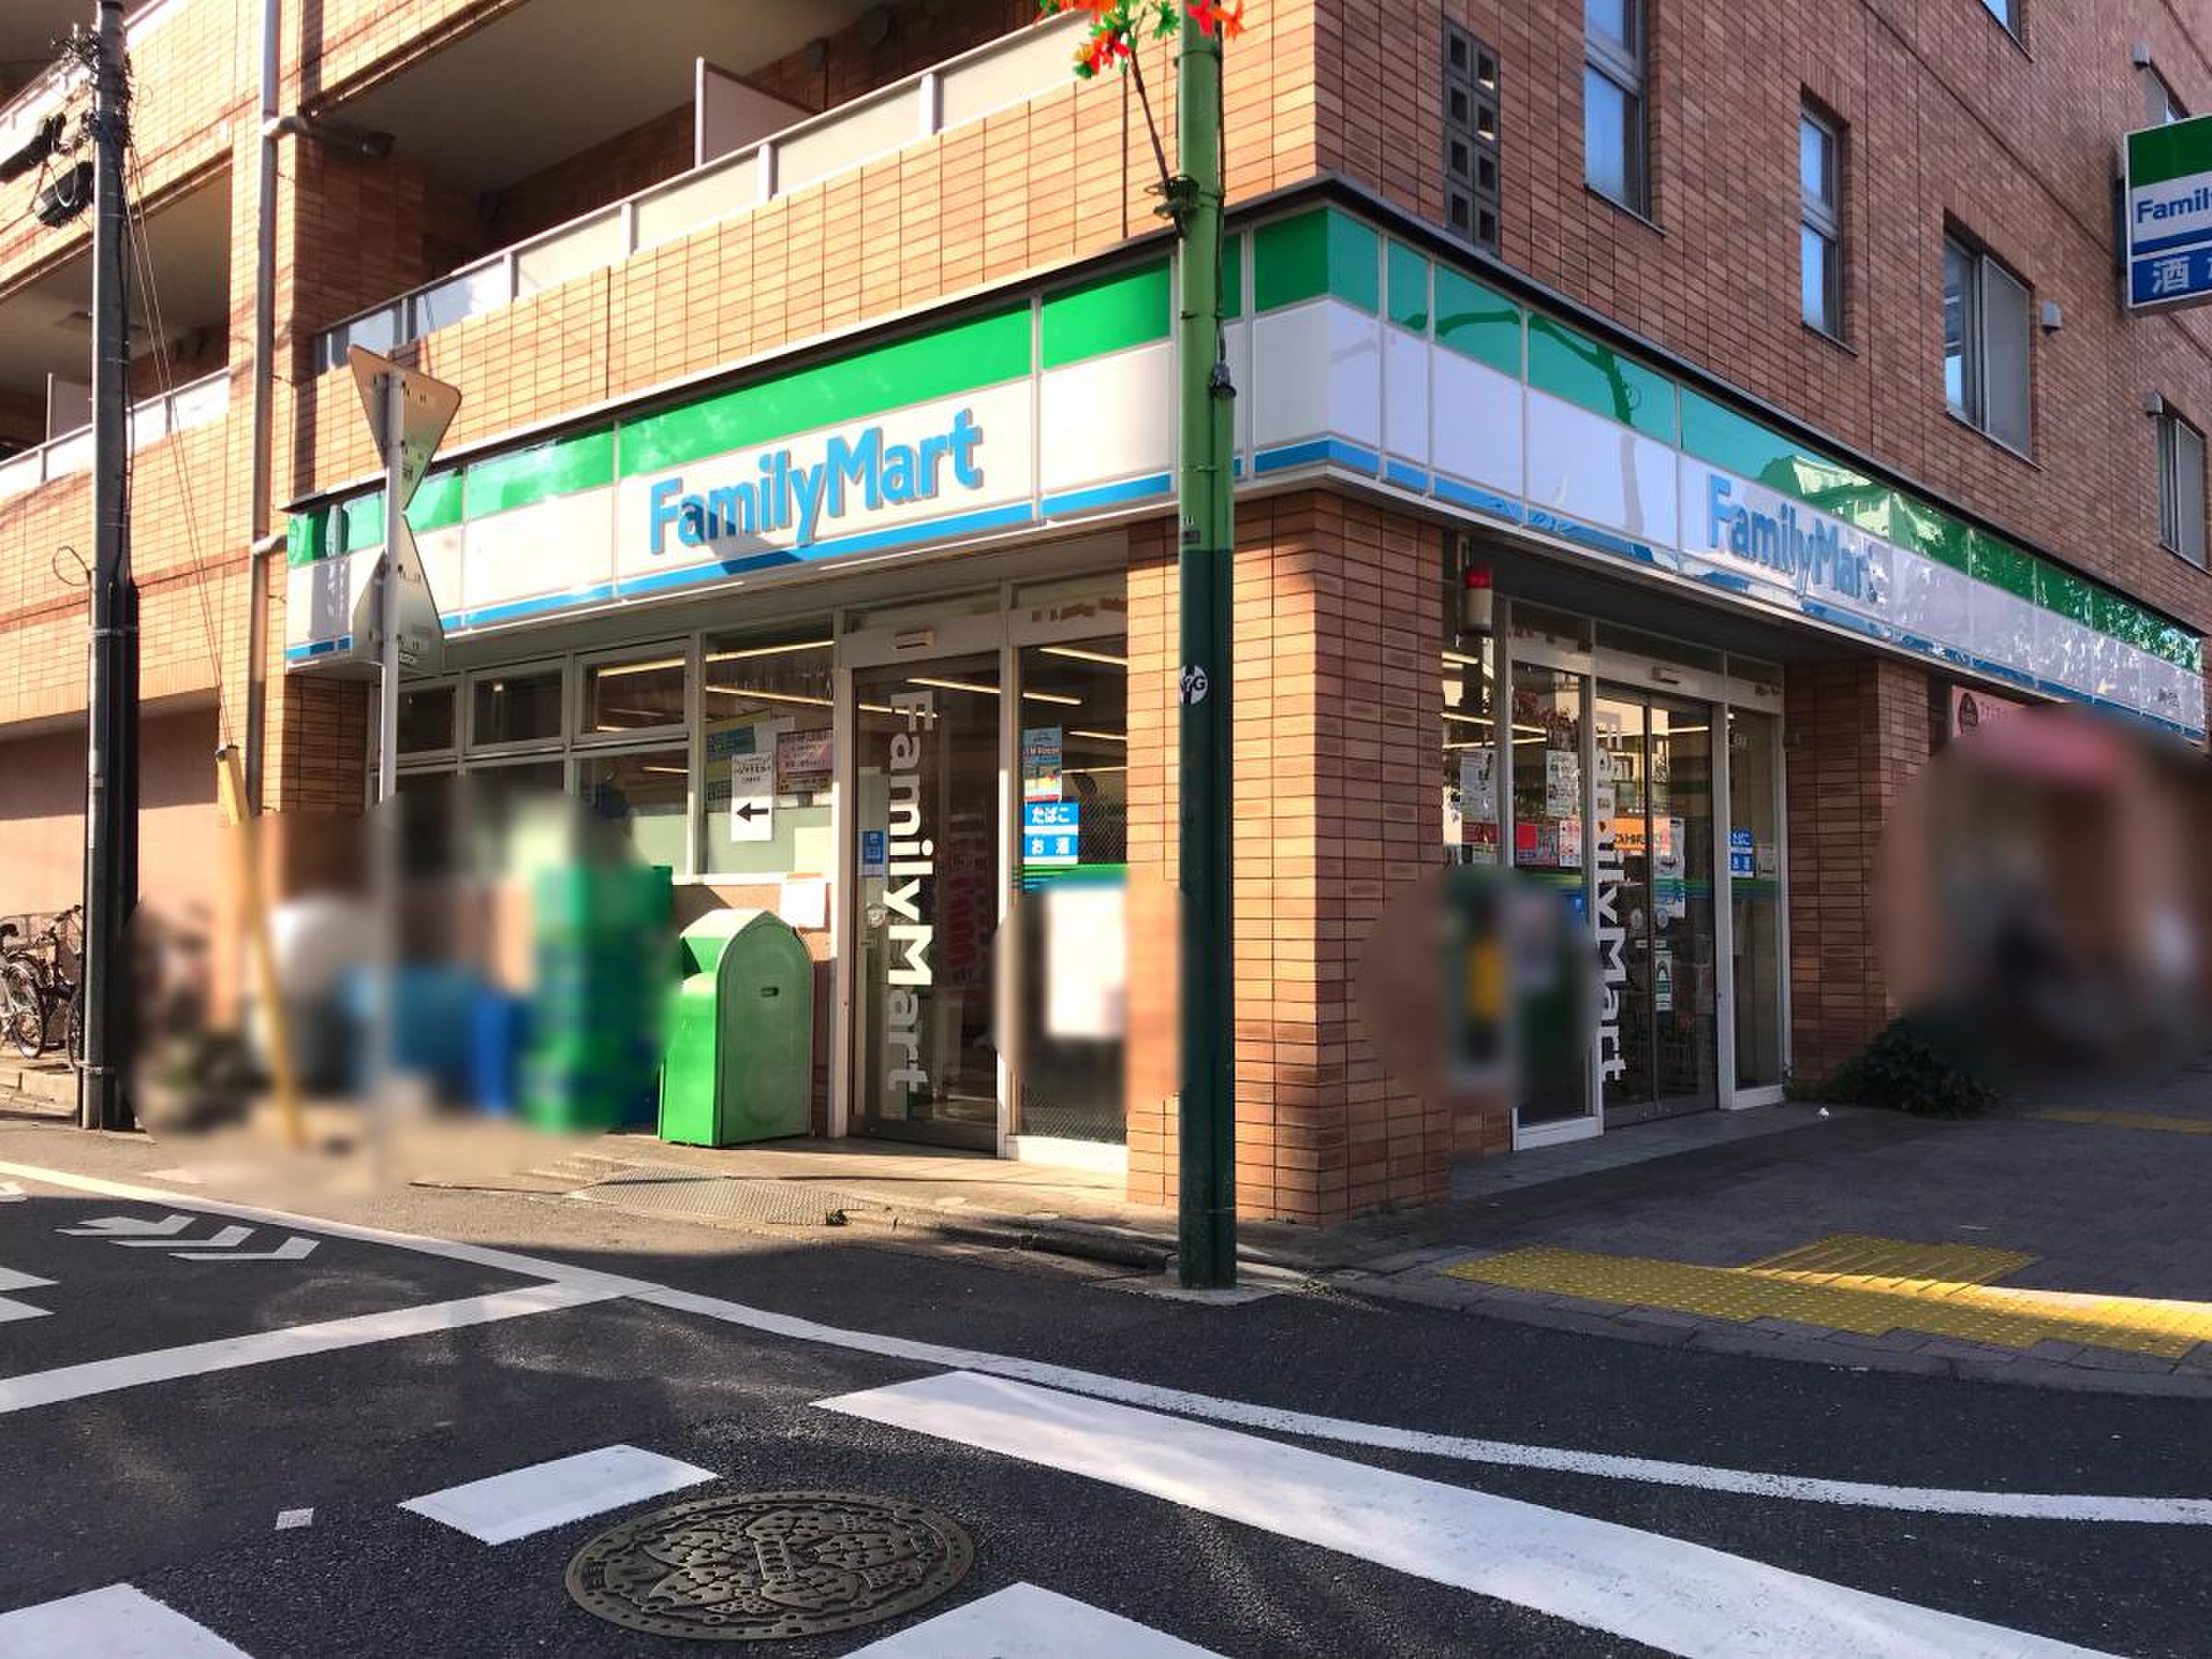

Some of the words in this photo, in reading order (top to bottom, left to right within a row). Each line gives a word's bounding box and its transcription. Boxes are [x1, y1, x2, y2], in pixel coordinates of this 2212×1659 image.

[2137, 187, 2212, 223] Famil
[651, 407, 983, 555] FamilyMart
[1710, 473, 1878, 605] FamilyMart
[1032, 806, 1070, 824] たばこ
[882, 690, 934, 1094] FamilyMart
